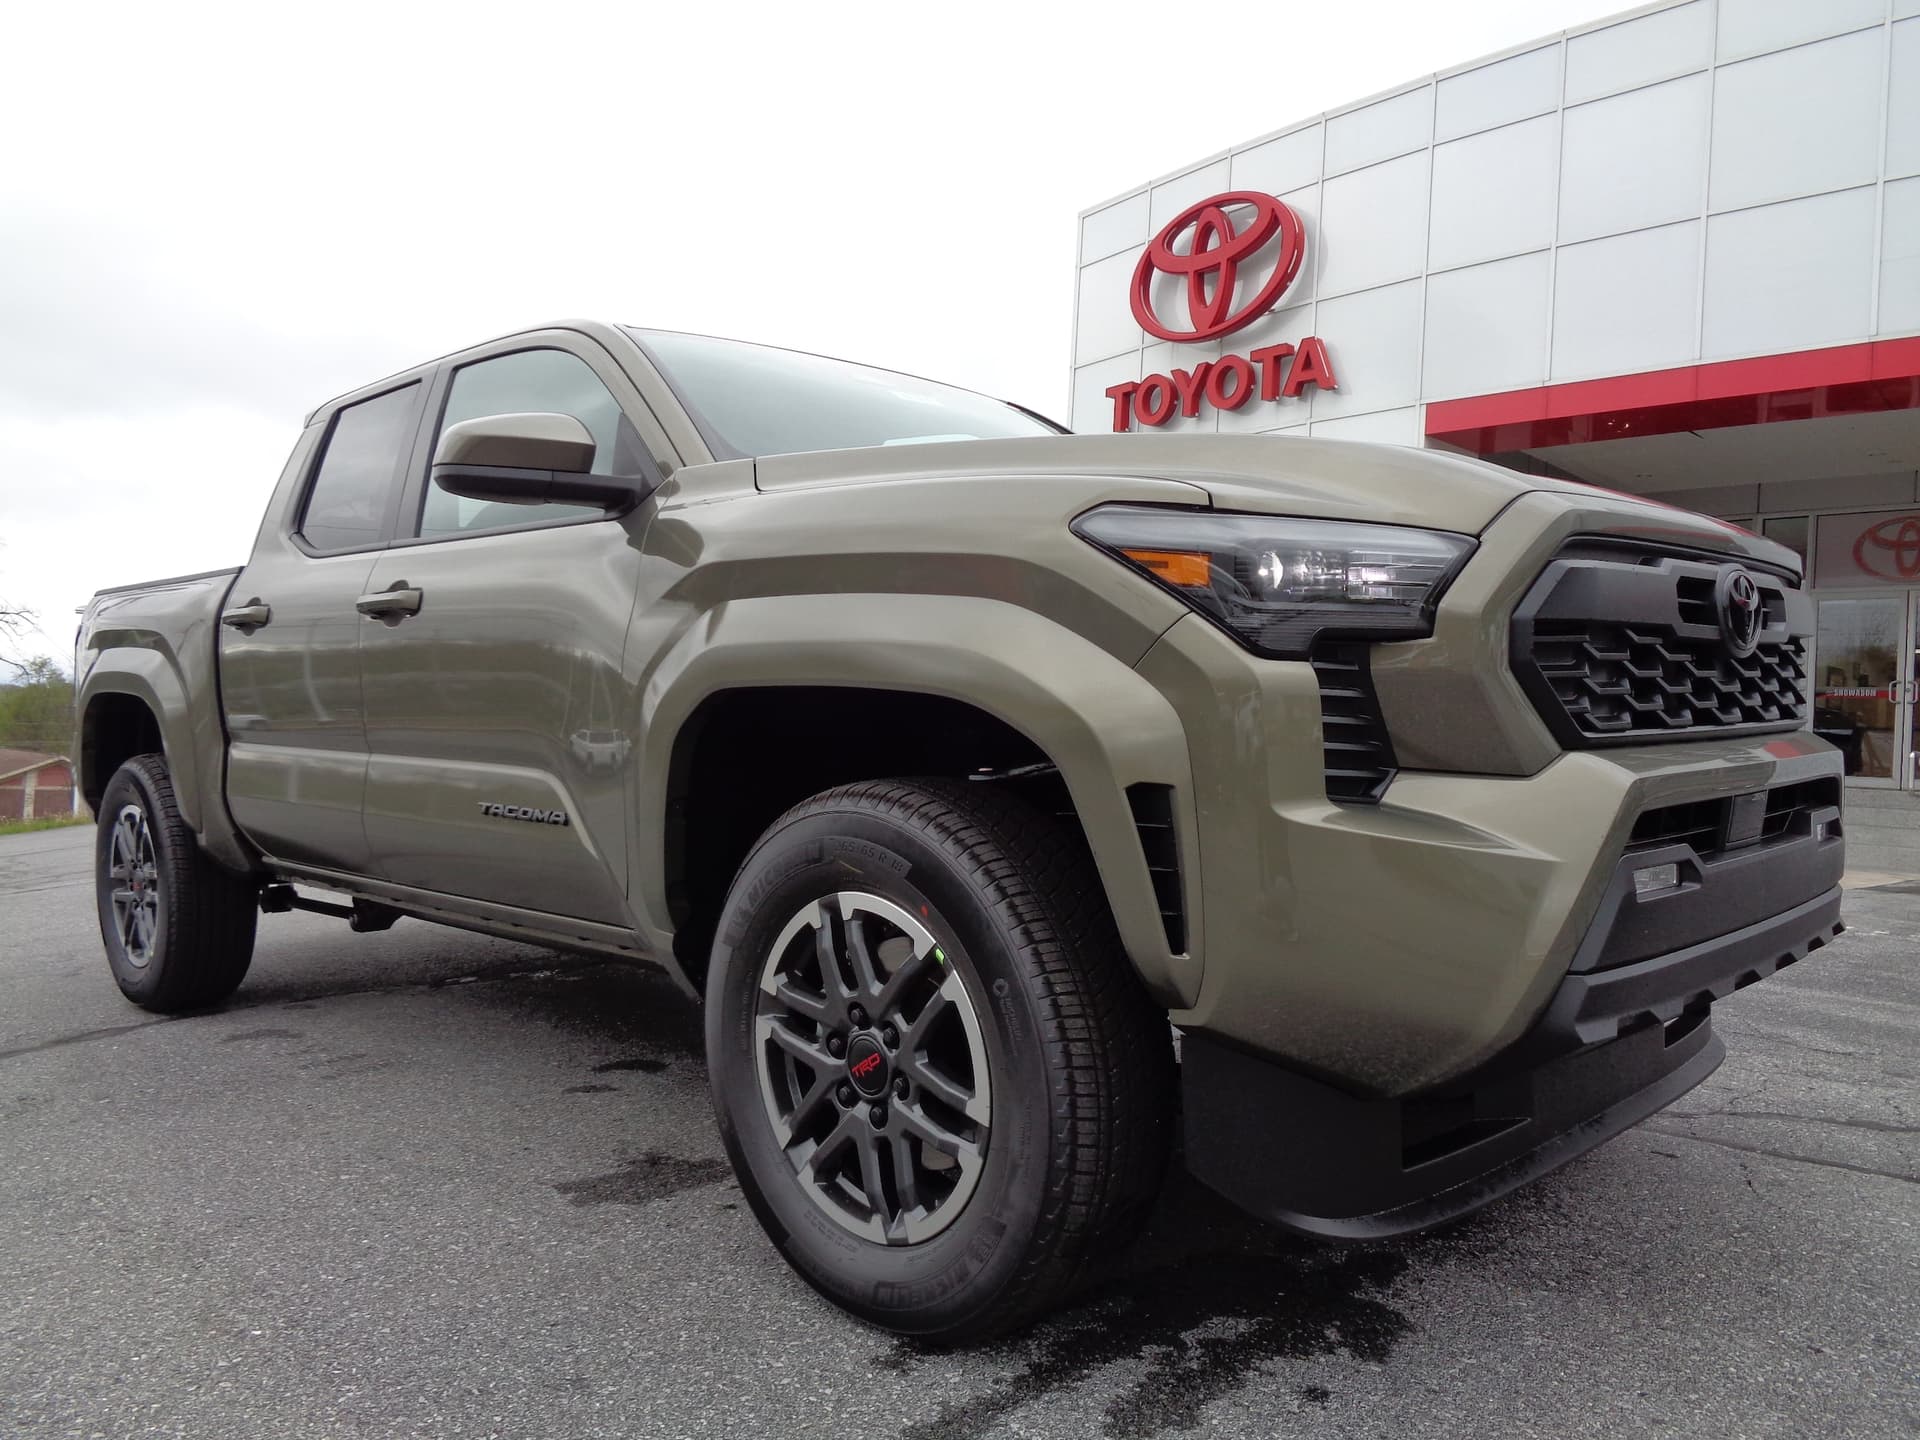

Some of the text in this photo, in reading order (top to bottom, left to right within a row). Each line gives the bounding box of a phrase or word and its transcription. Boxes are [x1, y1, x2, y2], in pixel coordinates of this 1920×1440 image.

[1106, 336, 1338, 432] TOYOTA
[478, 801, 570, 826] TACOMA
[851, 1053, 881, 1077] TRD
